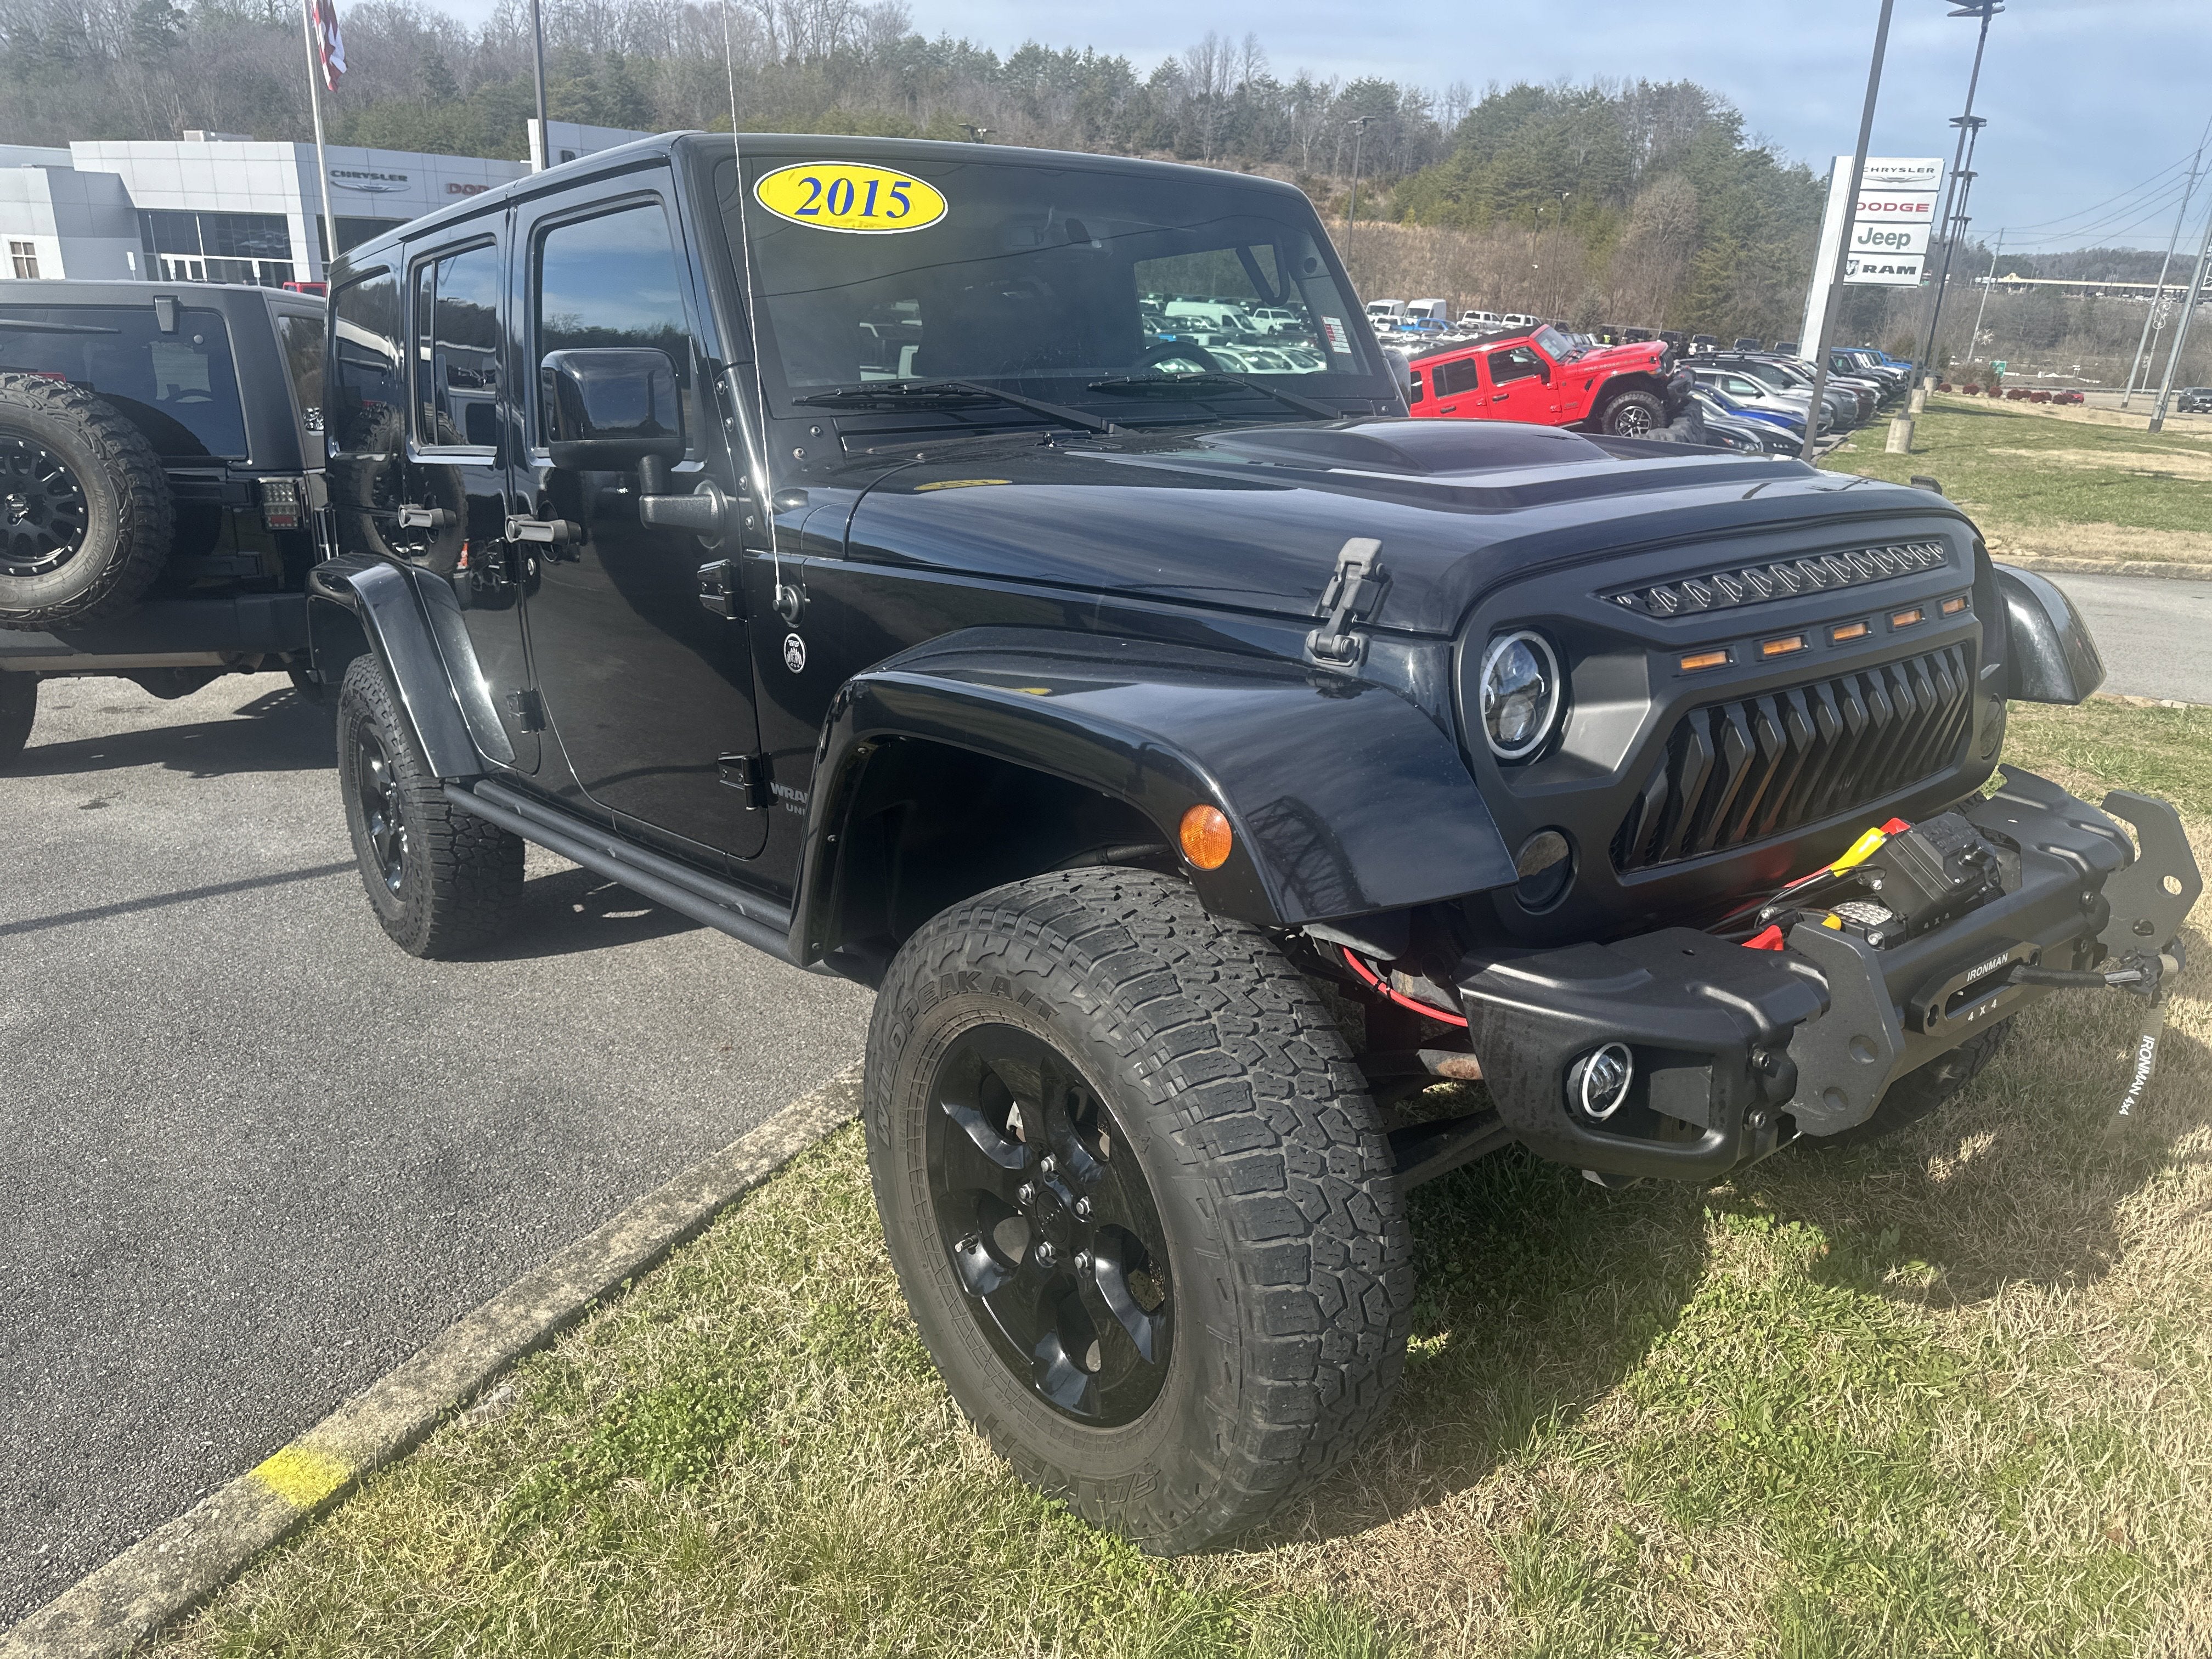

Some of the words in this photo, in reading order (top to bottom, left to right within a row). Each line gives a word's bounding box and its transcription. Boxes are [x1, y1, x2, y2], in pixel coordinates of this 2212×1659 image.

[330, 170, 408, 182] CHRYSLER
[794, 177, 912, 218] 2015
[1857, 202, 1930, 212] DODGE
[1858, 227, 1911, 250] Jeep
[1862, 264, 1917, 275] RAM
[94, 489, 110, 526] PRO
[83, 528, 108, 575] COMP
[1967, 952, 2008, 982] IRONMAN
[877, 970, 982, 1150] WILDPEAK
[2128, 1035, 2155, 1096] IRONMAN
[2118, 1096, 2135, 1116] 4x4
